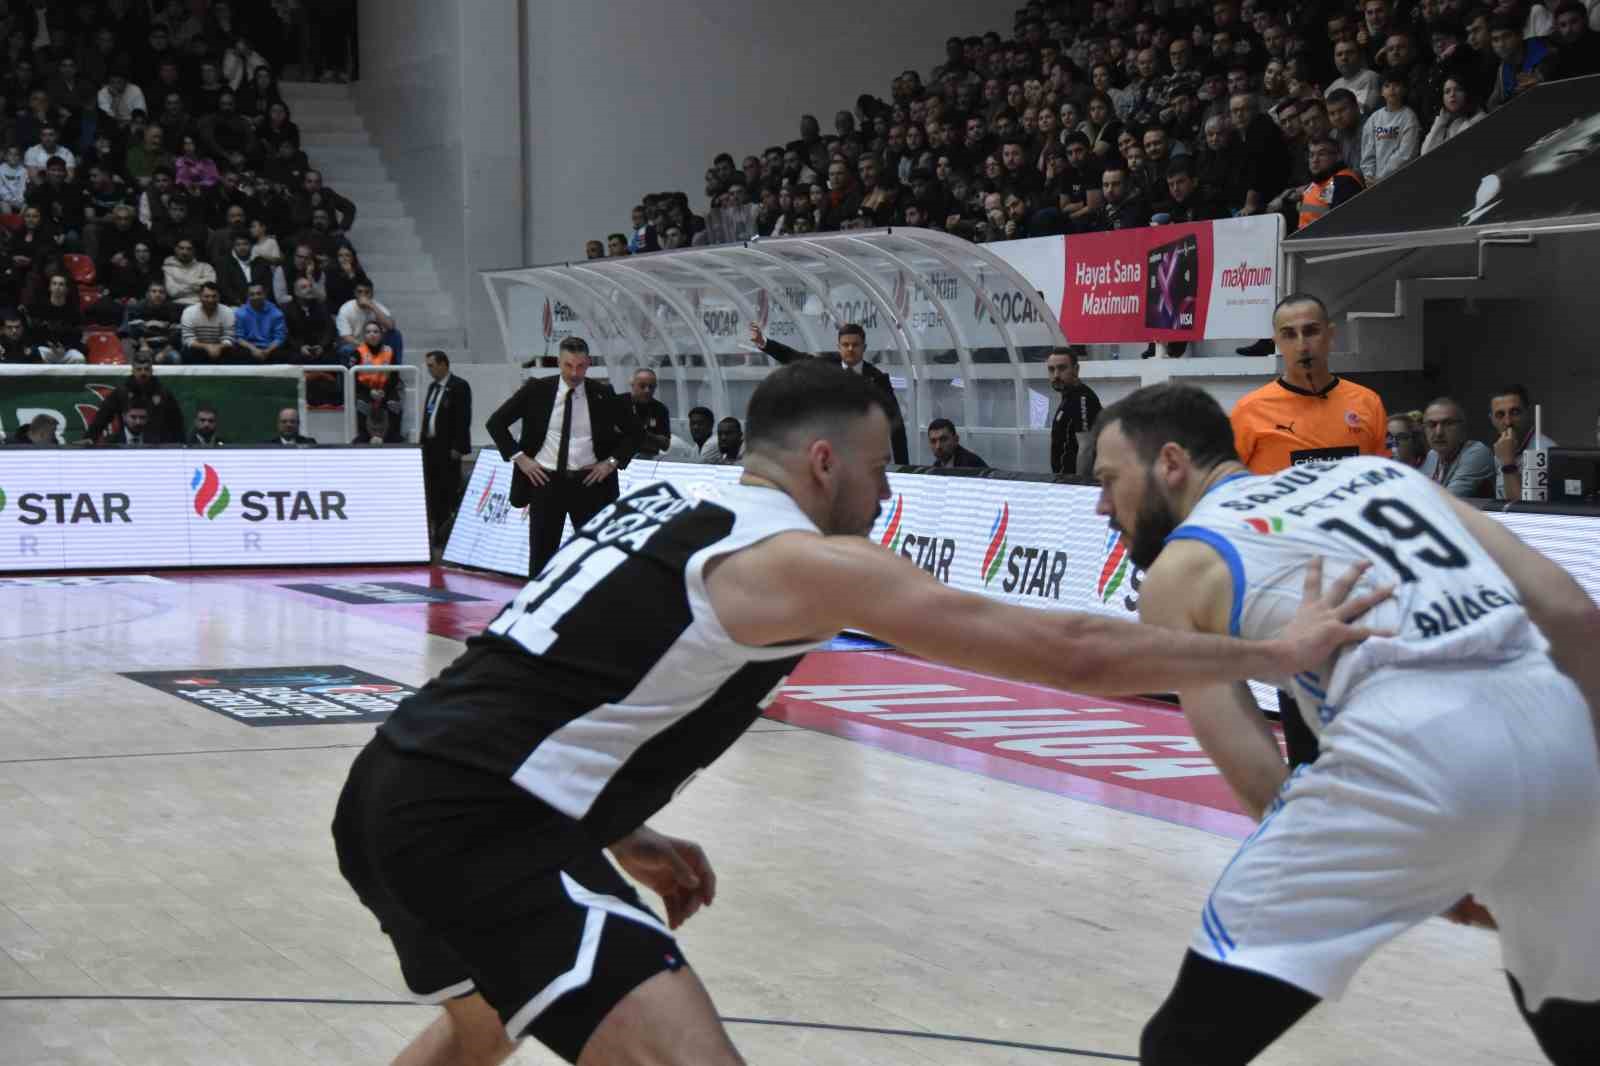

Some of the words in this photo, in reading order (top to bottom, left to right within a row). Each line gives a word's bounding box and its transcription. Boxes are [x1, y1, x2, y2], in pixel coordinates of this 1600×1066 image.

[1075, 261, 1112, 291] Hayat
[1114, 259, 1141, 283] Sana
[1221, 261, 1272, 292] maximum
[1081, 291, 1140, 316] Maximum
[1179, 312, 1193, 326] VISA
[1536, 452, 1546, 467] 3
[1537, 471, 1547, 486] 2
[17, 492, 132, 525] STAR
[240, 490, 348, 522] STAR
[1317, 498, 1469, 583] 19
[901, 533, 955, 584] STAR
[1002, 545, 1068, 600] STAR
[1413, 584, 1521, 639] ALİAĞ
